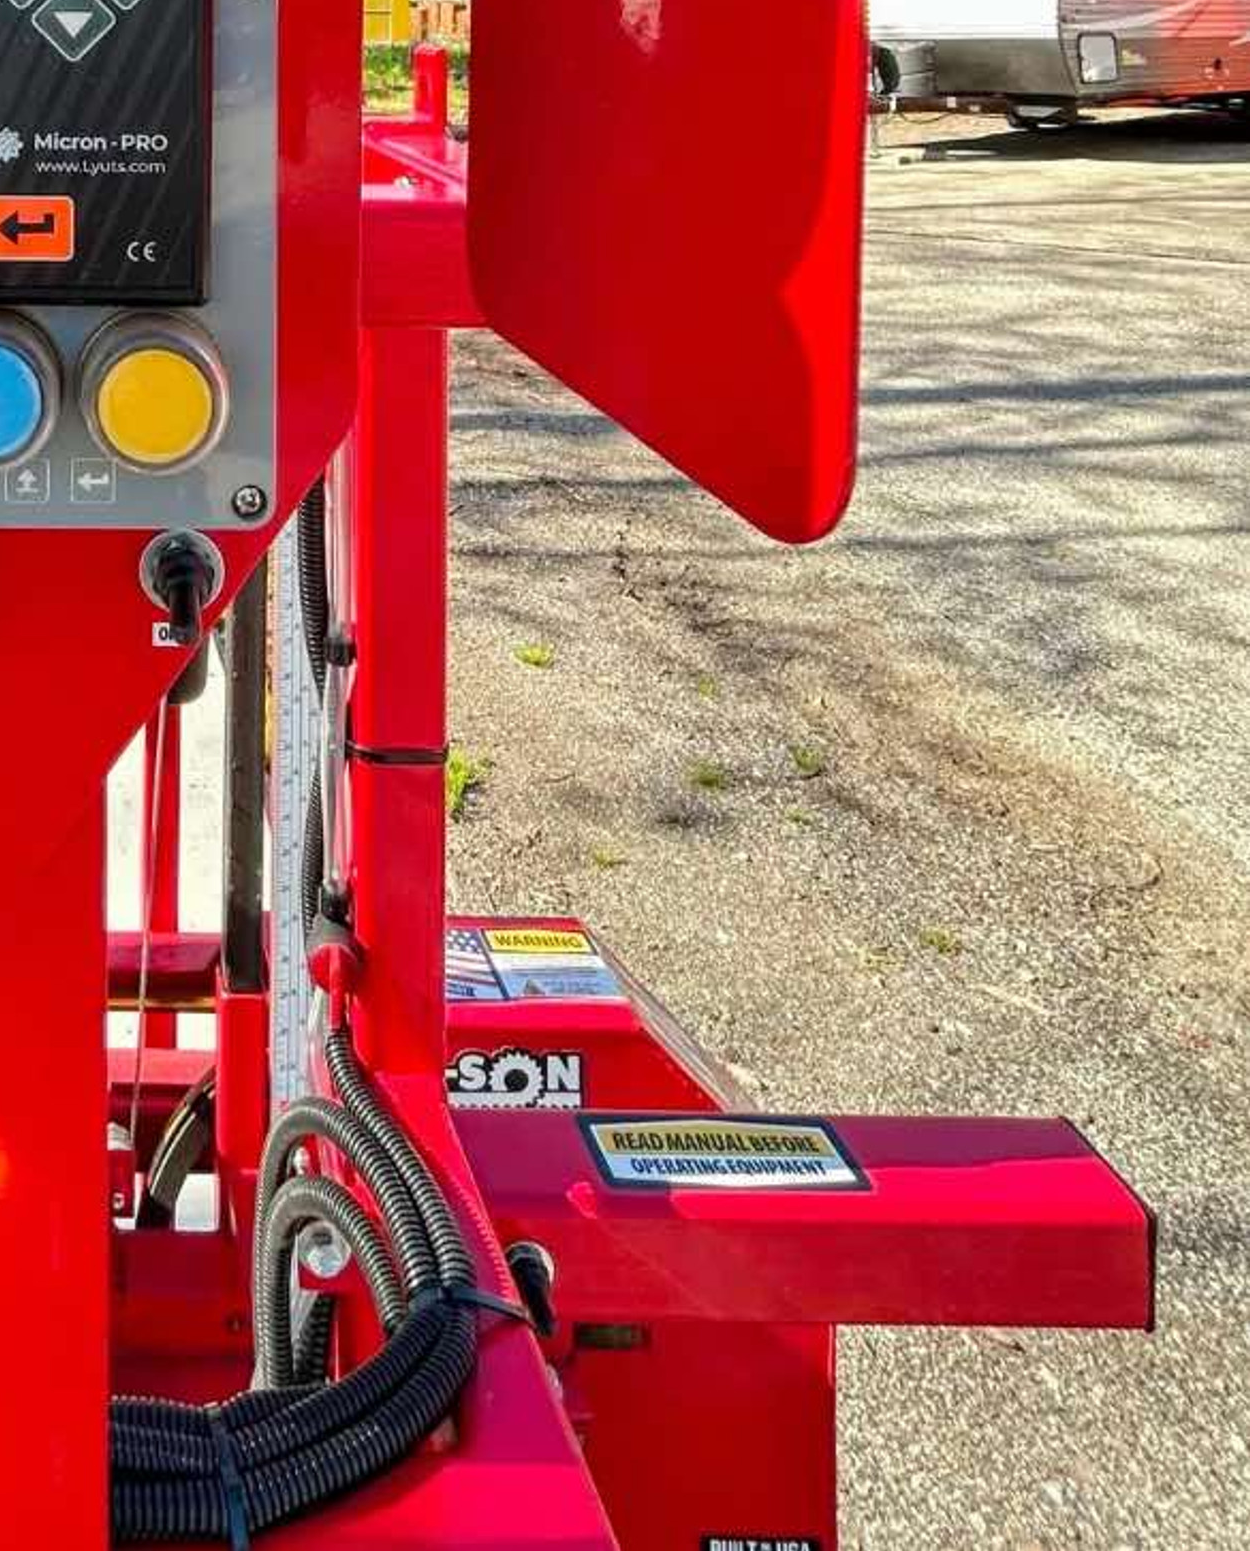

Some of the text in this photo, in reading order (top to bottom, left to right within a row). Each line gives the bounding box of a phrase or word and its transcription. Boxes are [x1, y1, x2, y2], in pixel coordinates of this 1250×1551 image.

[34, 132, 107, 151] Micron
[121, 134, 169, 152] PRO
[493, 934, 584, 949] WARNING
[612, 1131, 820, 1154] READ MANUAL BEFORE
[630, 1157, 827, 1176] OPERATING EQUIPMENT
